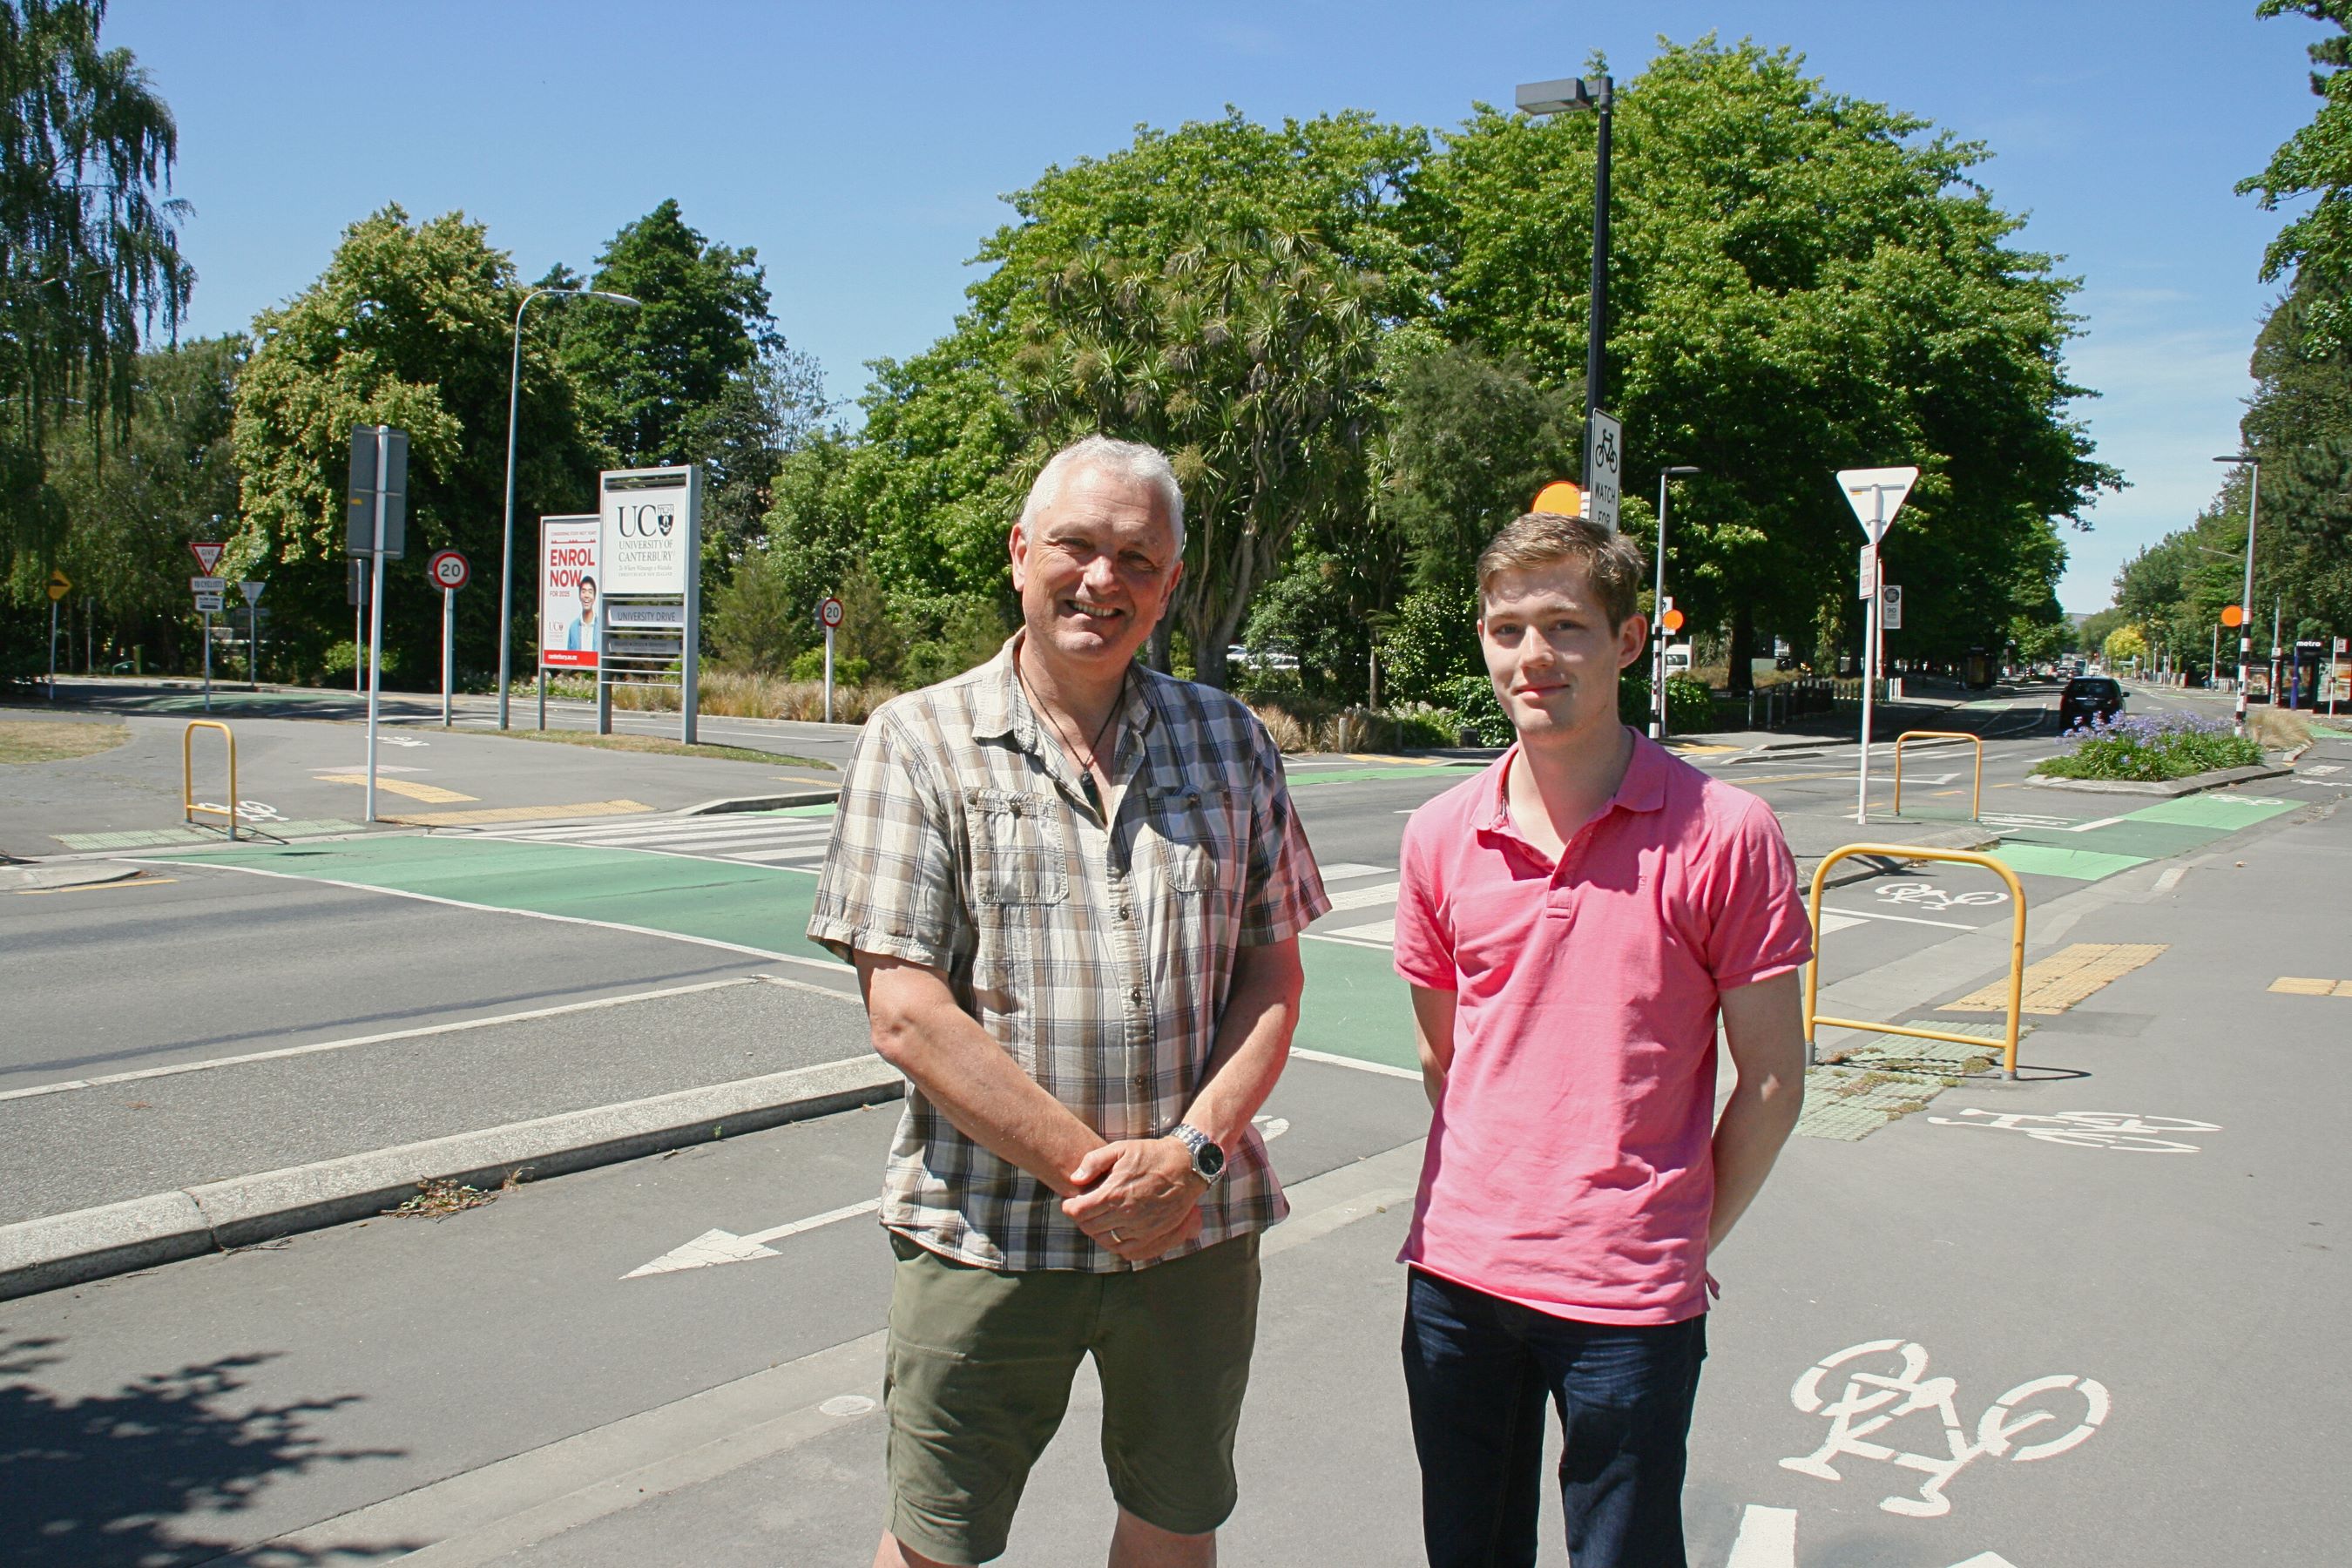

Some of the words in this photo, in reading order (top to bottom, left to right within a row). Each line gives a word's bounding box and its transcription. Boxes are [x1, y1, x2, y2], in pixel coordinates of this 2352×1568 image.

[1595, 482, 1616, 505] WATCH
[617, 504, 657, 537] UC
[618, 540, 664, 550] UNIVERSITY
[664, 539, 673, 549] OF
[550, 548, 596, 567] ENROL
[618, 551, 673, 563] CANTERBURY
[441, 564, 461, 578] 20
[550, 569, 583, 587] NOW
[618, 612, 656, 621] UNIVERSITY
[656, 612, 676, 621] DRIVE
[826, 606, 840, 618] 20
